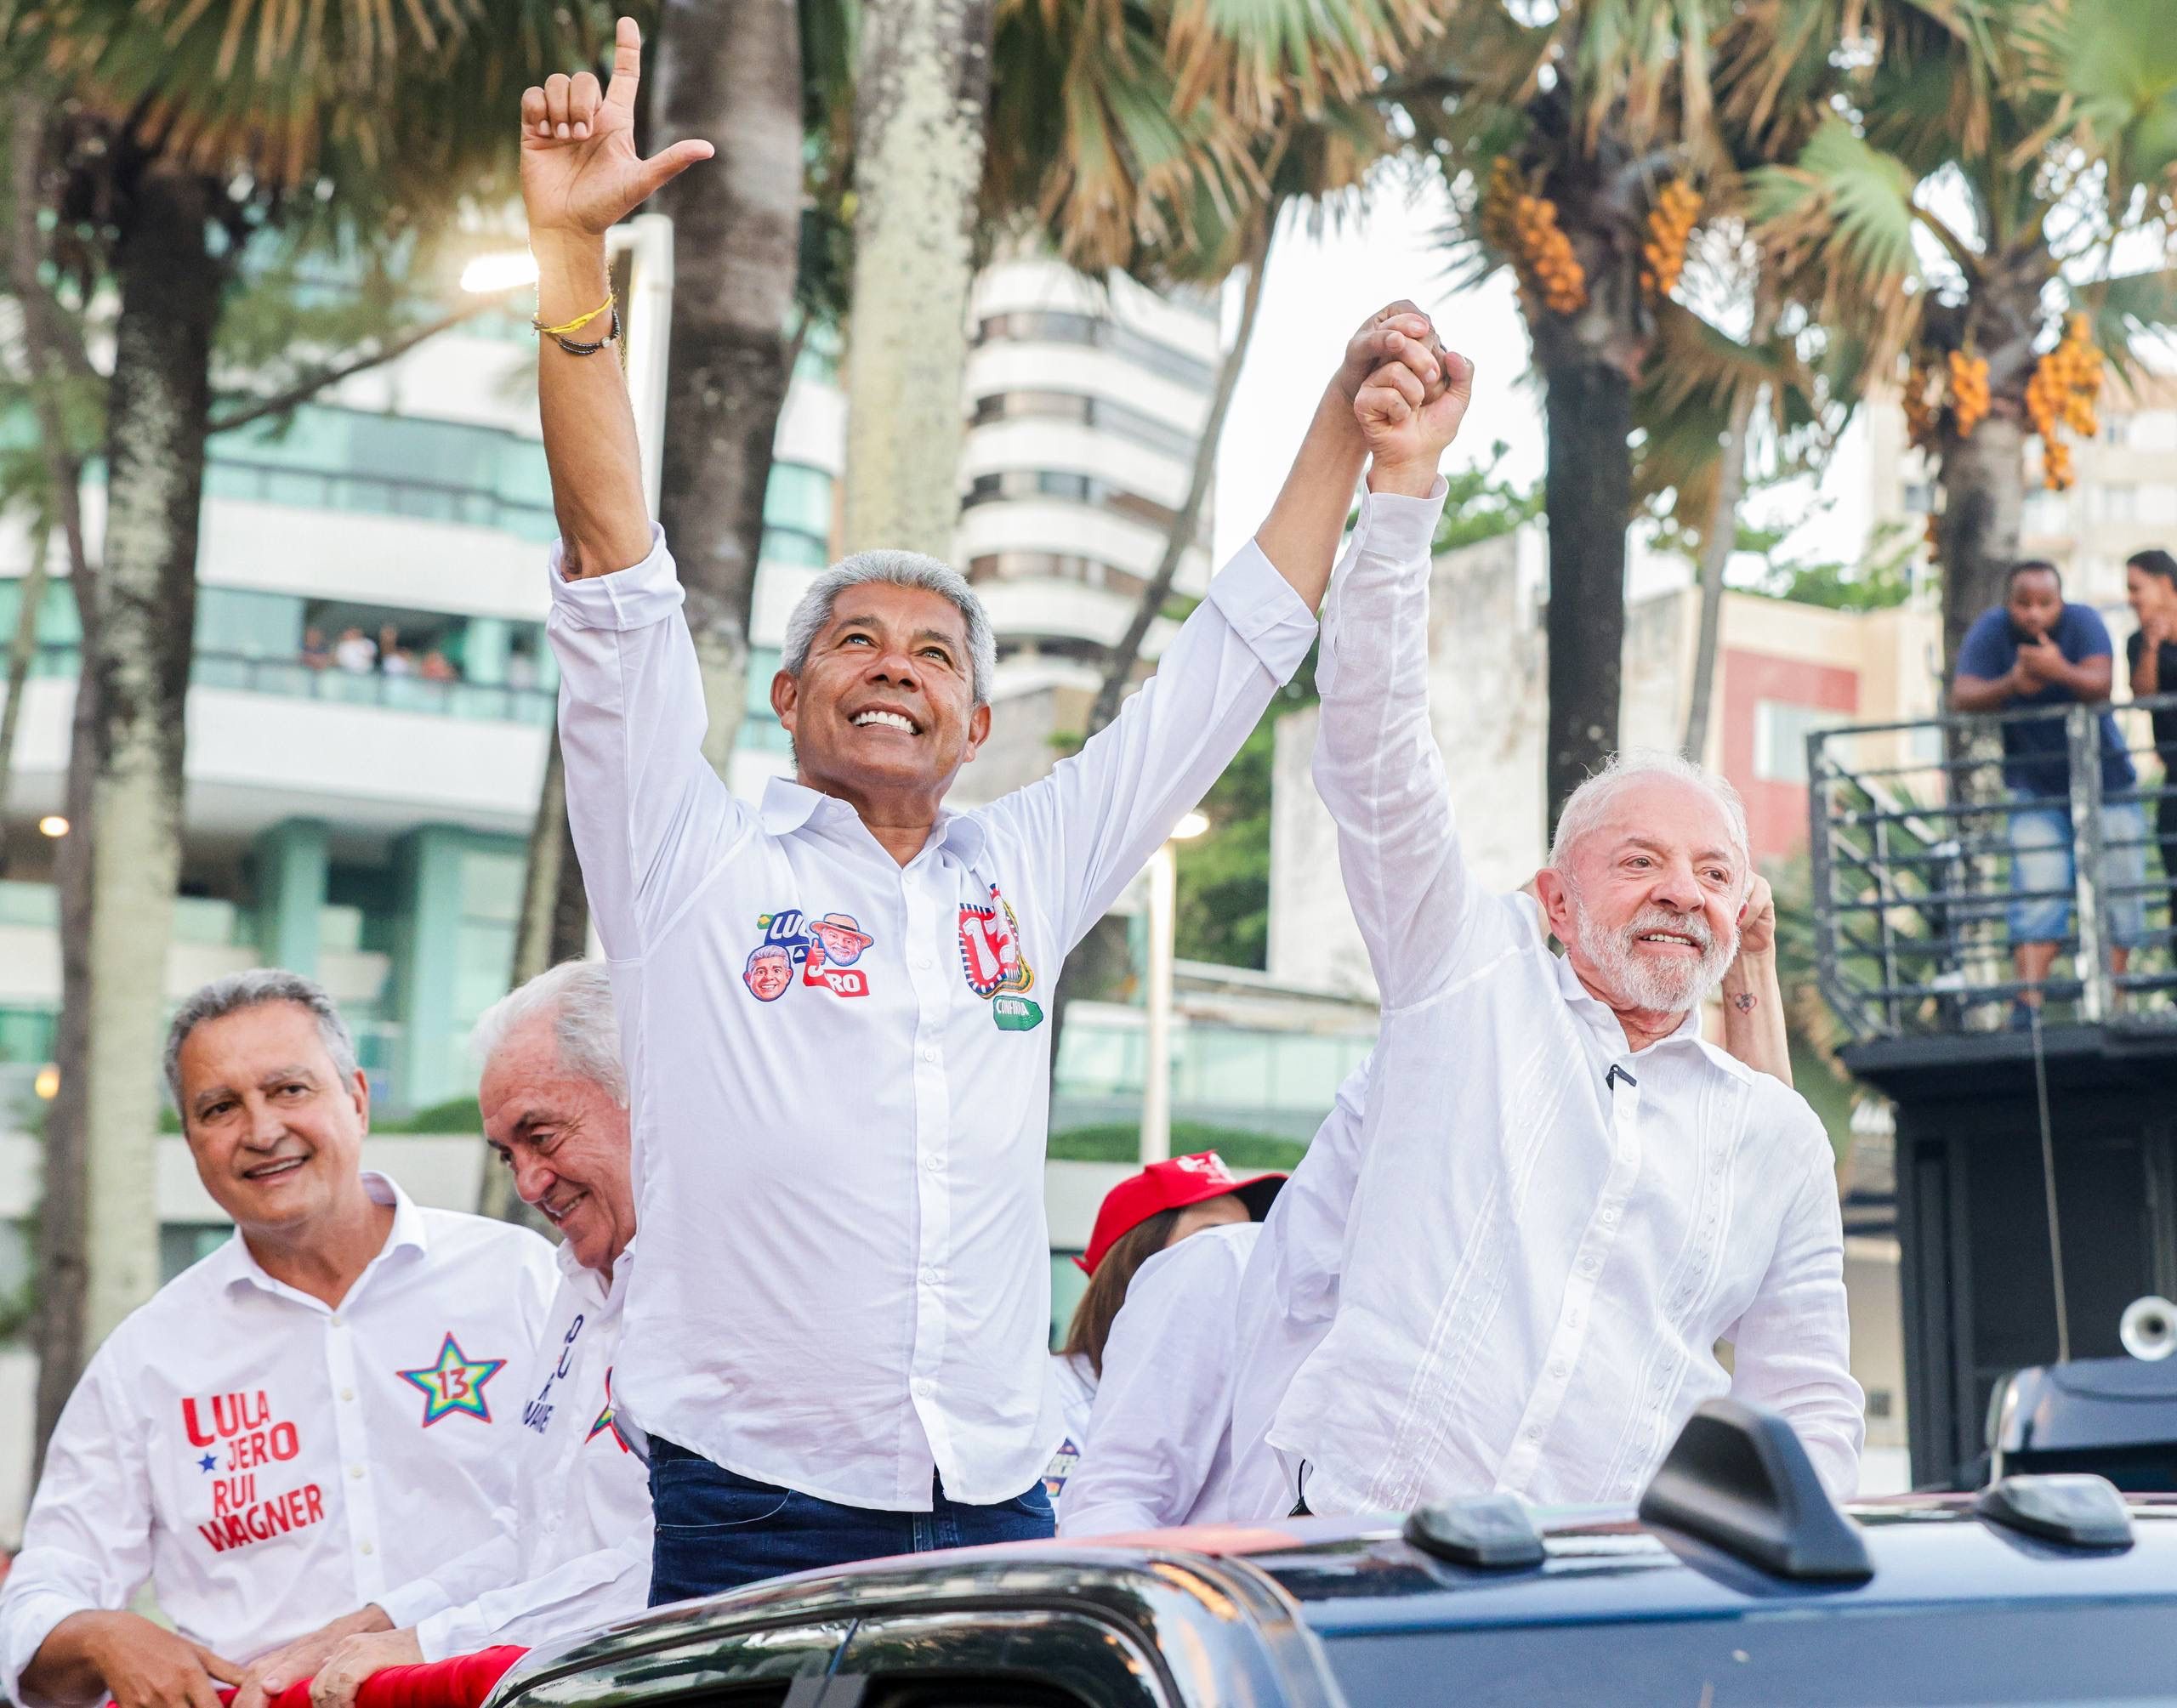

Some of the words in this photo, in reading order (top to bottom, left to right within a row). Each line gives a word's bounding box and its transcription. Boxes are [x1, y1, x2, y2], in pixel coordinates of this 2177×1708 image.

[807, 964, 861, 993] JRO
[436, 1366, 470, 1400] 13
[181, 1389, 271, 1448] LULA
[226, 1421, 300, 1473] JERO
[197, 1484, 325, 1553] WAGNER
[213, 1473, 256, 1518] RUI
